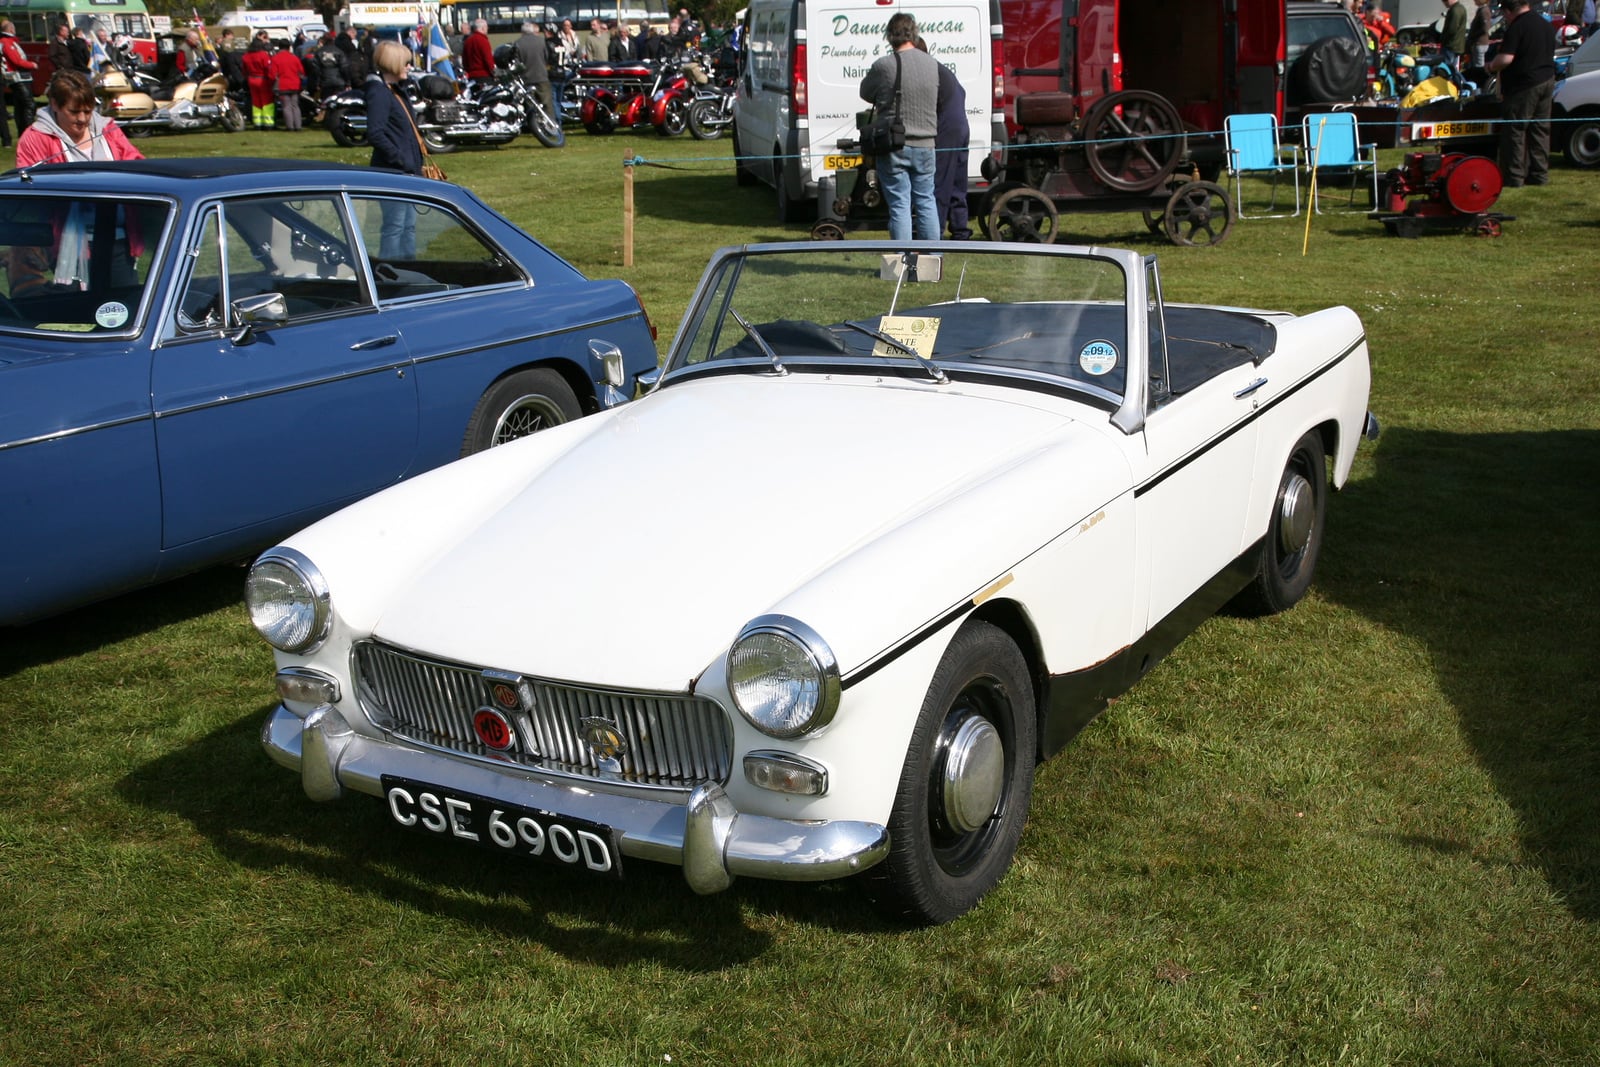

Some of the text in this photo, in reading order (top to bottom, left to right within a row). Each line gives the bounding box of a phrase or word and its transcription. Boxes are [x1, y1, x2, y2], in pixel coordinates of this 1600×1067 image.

[832, 14, 965, 41] Danny uncan
[821, 45, 867, 59] Plumbing
[873, 44, 880, 55] &
[928, 43, 977, 56] Contractor
[1436, 123, 1462, 135] P665
[828, 156, 858, 168] SG57
[1091, 346, 1104, 355] 09
[495, 685, 516, 706] MG
[480, 717, 504, 743] MG
[388, 786, 612, 873] CSE 690D
